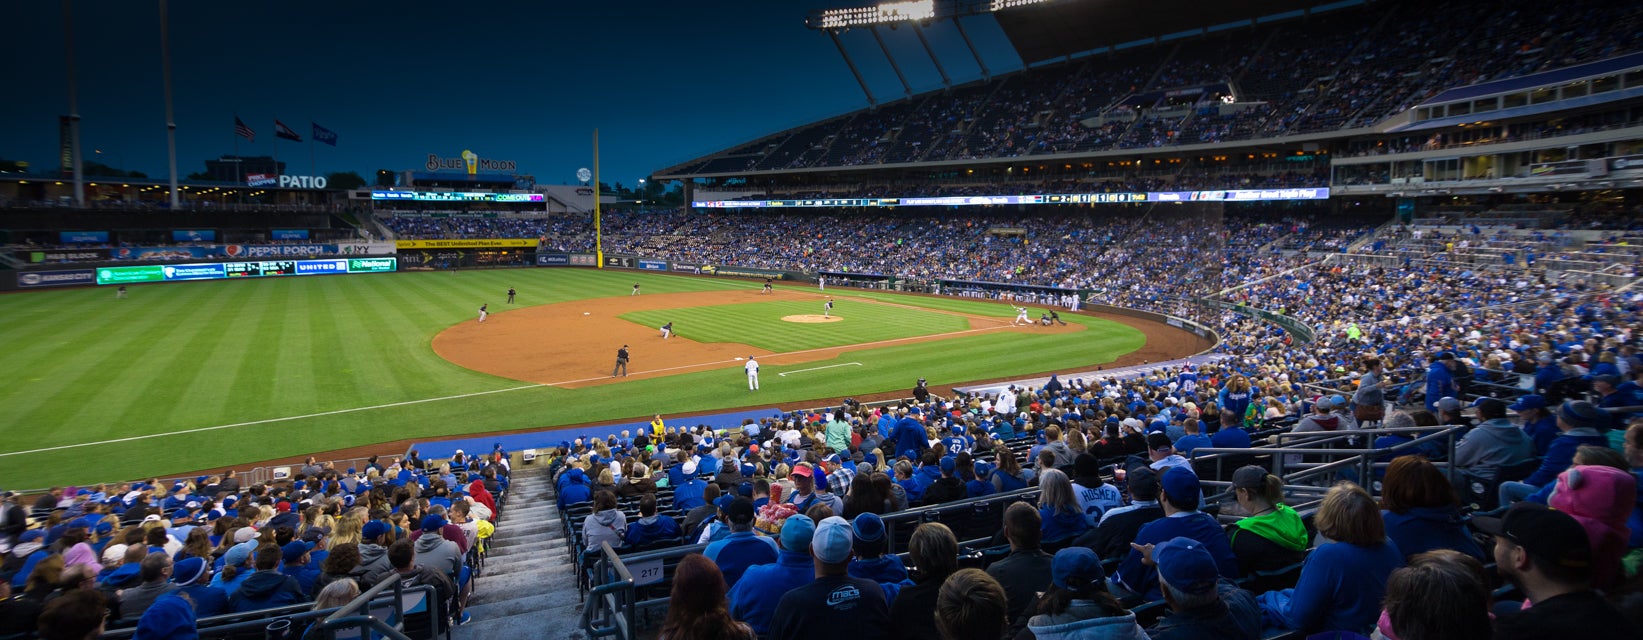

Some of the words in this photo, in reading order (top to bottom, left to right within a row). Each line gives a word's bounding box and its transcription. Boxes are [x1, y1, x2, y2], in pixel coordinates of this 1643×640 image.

[426, 153, 462, 171] BLUE
[480, 158, 517, 171] MOON
[279, 175, 327, 189] PATIO
[248, 246, 281, 257] PEPSI
[284, 246, 323, 255] PORCH
[299, 263, 336, 271] UNITED
[361, 260, 391, 268] National
[949, 443, 962, 454] 47
[1081, 488, 1116, 502] HOSMER
[641, 567, 659, 578] 217
